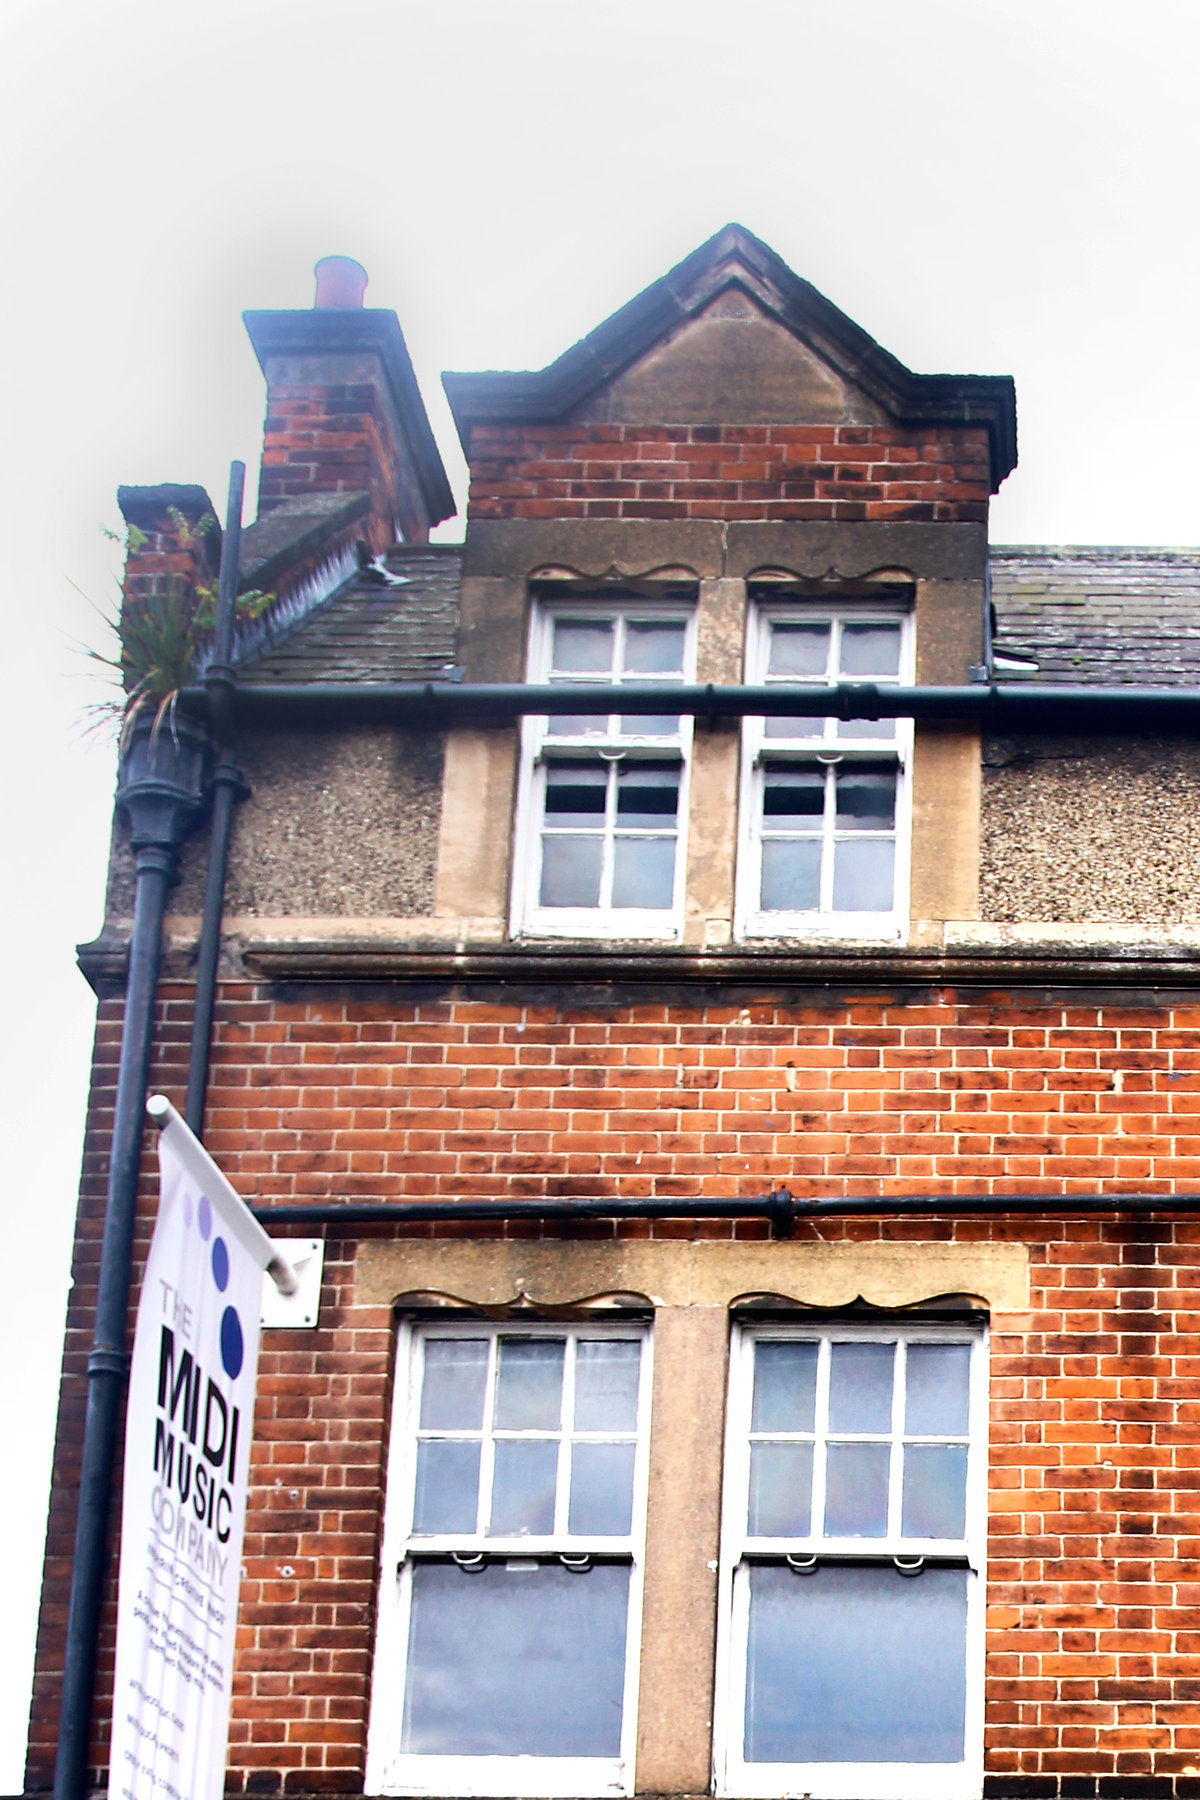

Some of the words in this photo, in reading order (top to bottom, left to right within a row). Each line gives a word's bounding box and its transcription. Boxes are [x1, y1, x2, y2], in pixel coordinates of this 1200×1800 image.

[159, 1278, 192, 1340] THE
[157, 1324, 239, 1485] MIDI
[151, 1485, 228, 1587] COMPANY
[153, 1417, 232, 1543] MUSIC
